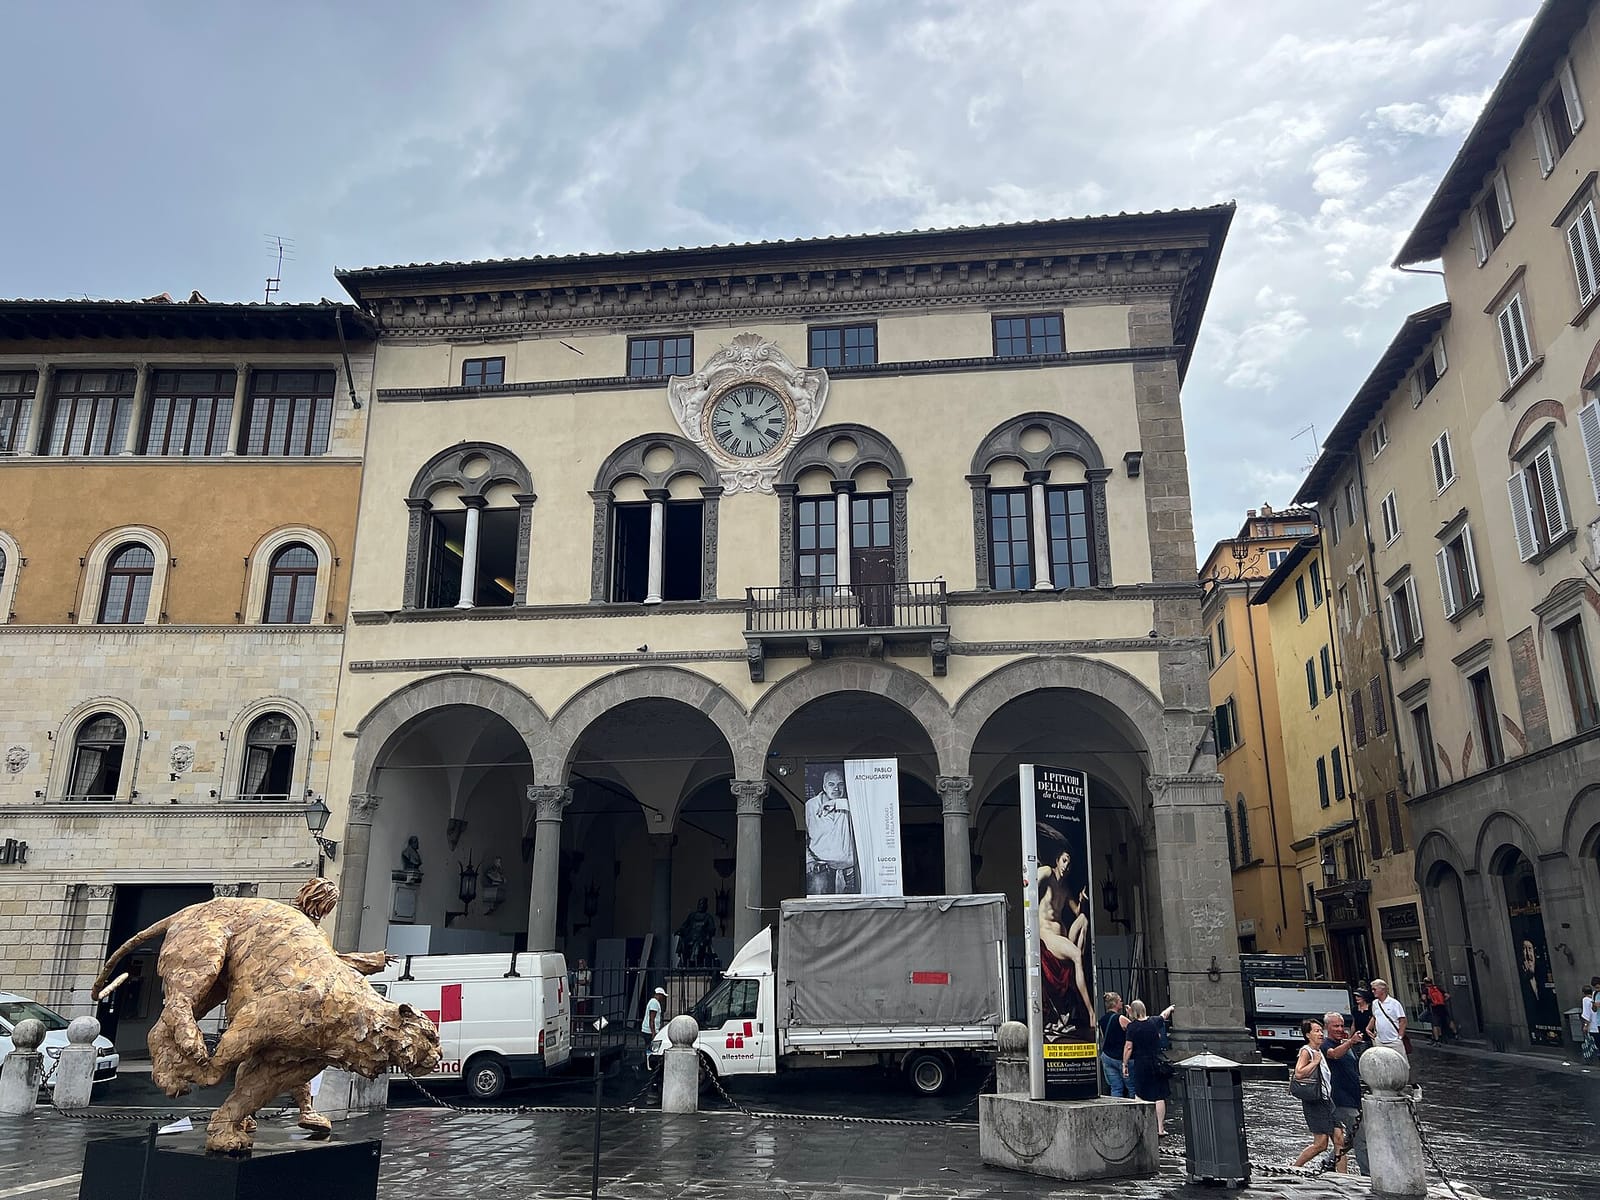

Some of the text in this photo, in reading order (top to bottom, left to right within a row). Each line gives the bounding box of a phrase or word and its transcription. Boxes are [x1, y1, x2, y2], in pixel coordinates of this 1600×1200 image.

[874, 766, 892, 774] PABLO
[855, 773, 892, 781] ATCHUGARRY
[1044, 772, 1079, 786] I PITTORI
[1038, 781, 1084, 797] DELLA LUCE
[1043, 791, 1051, 799] da
